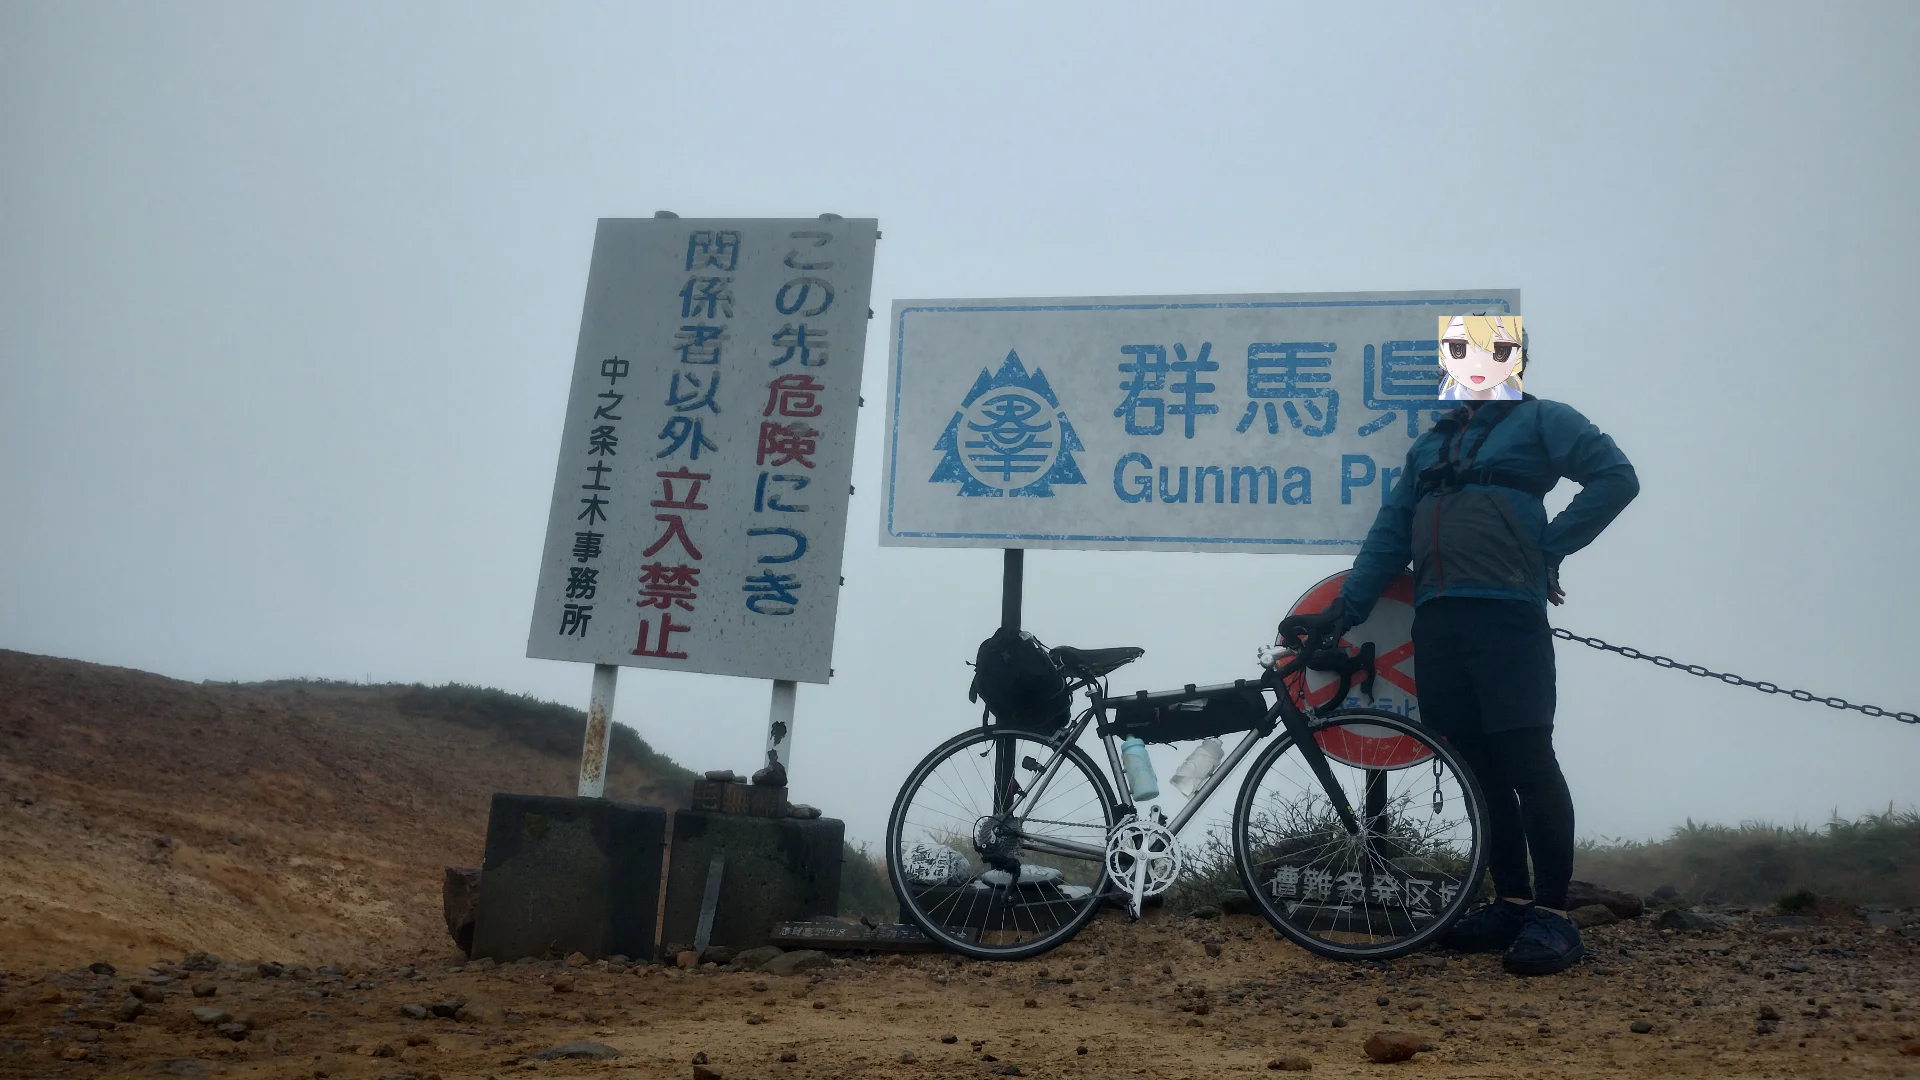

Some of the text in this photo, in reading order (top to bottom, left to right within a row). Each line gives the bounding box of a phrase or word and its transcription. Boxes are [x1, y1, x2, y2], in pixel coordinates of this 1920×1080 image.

[559, 355, 630, 637] 中之条土木事務所
[630, 229, 742, 659] 関係者以外立入禁止
[742, 230, 835, 615] この先危険につき
[1113, 340, 1463, 440] 群馬県
[1113, 452, 1313, 505] Gunma
